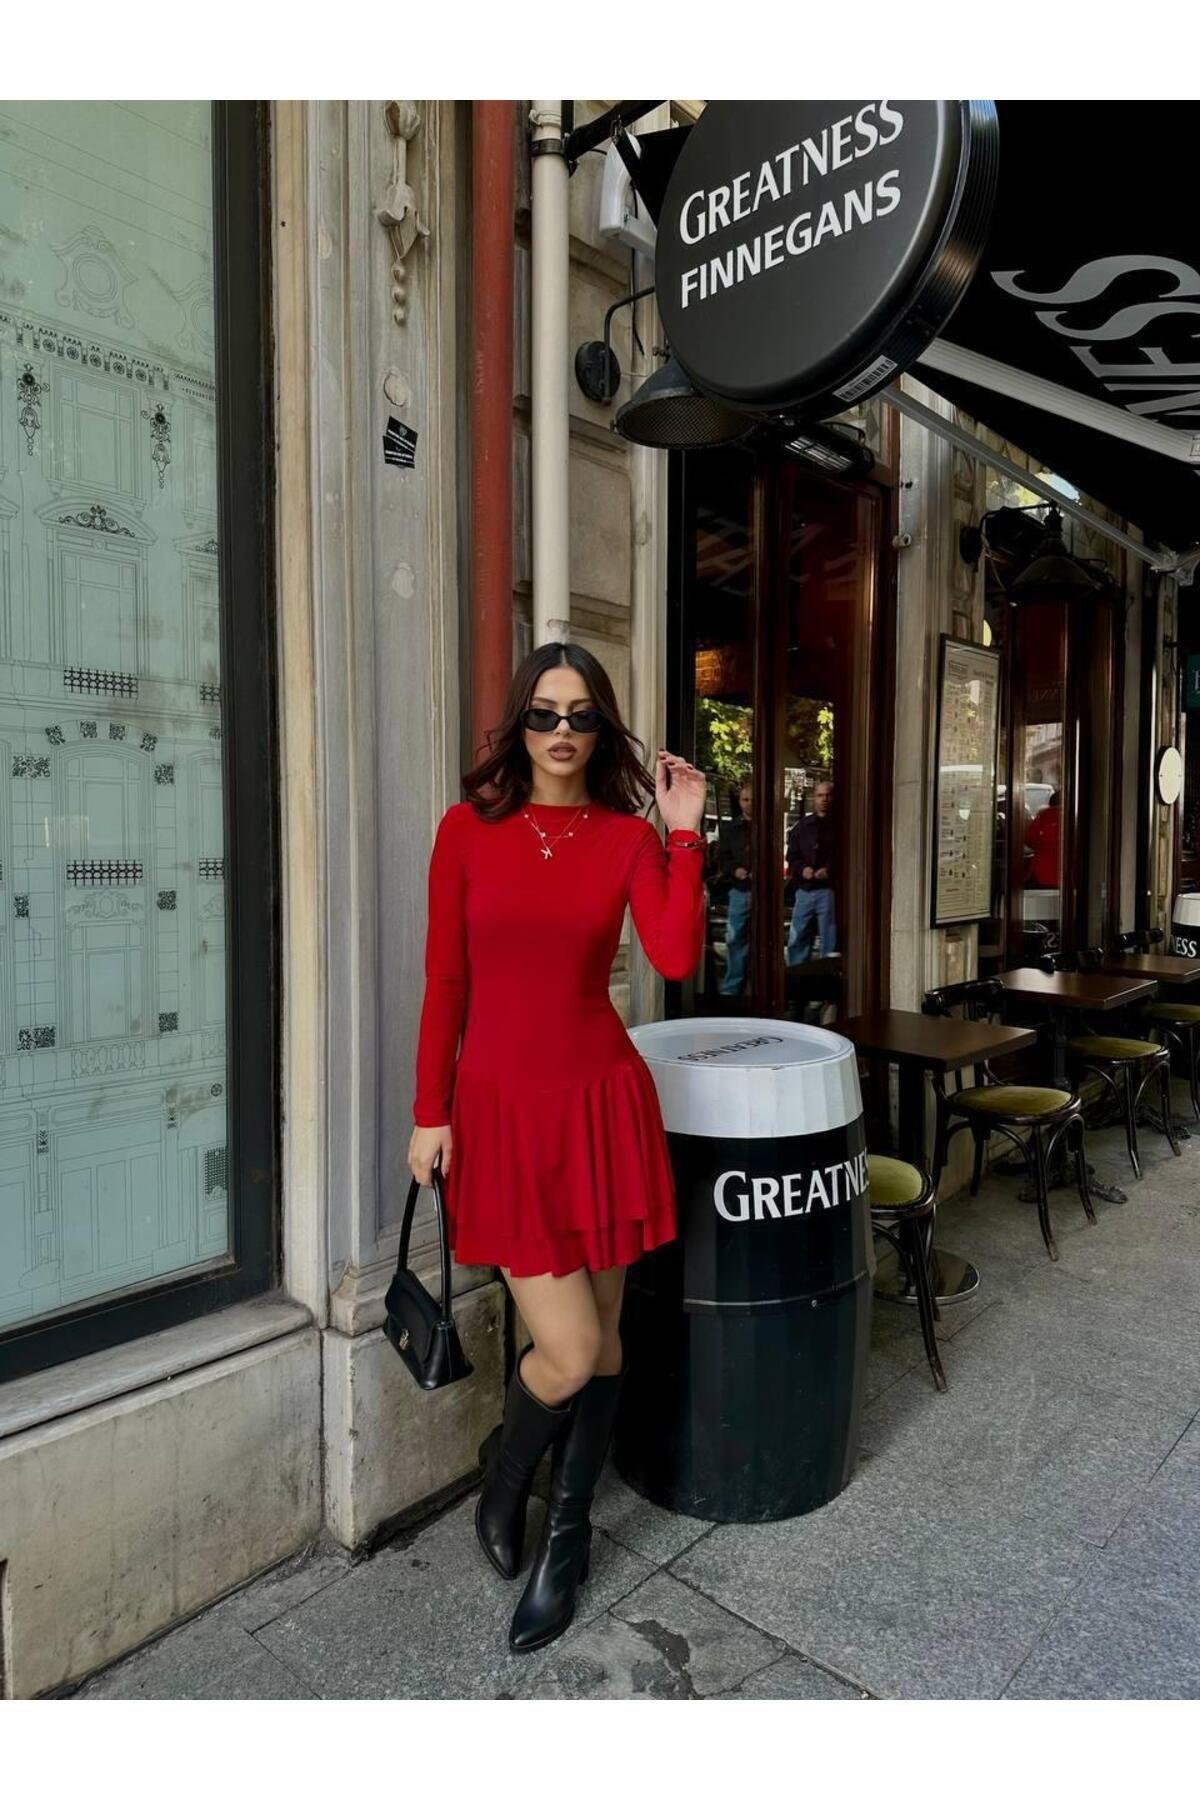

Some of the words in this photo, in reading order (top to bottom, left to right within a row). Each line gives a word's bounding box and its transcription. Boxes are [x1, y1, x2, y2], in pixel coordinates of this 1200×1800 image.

[679, 100, 903, 245] GREATNESS
[681, 169, 901, 309] FINNEGANS
[990, 254, 1200, 438] NESS
[1174, 936, 1198, 958] ESS
